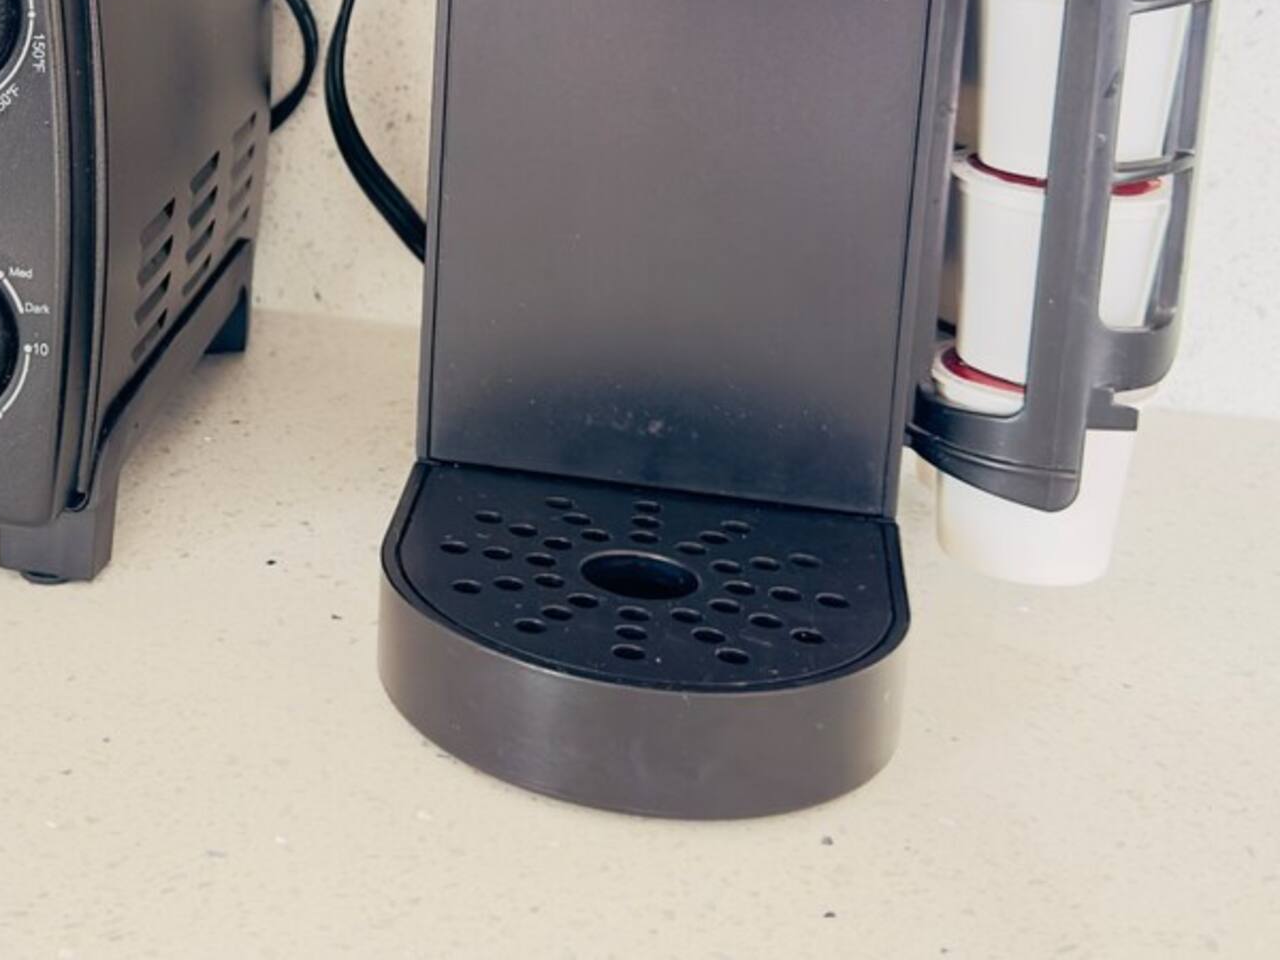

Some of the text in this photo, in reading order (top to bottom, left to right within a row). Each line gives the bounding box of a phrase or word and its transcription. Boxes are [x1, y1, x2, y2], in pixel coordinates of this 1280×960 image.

[32, 33, 46, 73] 150°F
[8, 266, 33, 279] Med
[25, 302, 51, 315] Dark
[33, 342, 50, 357] 10
